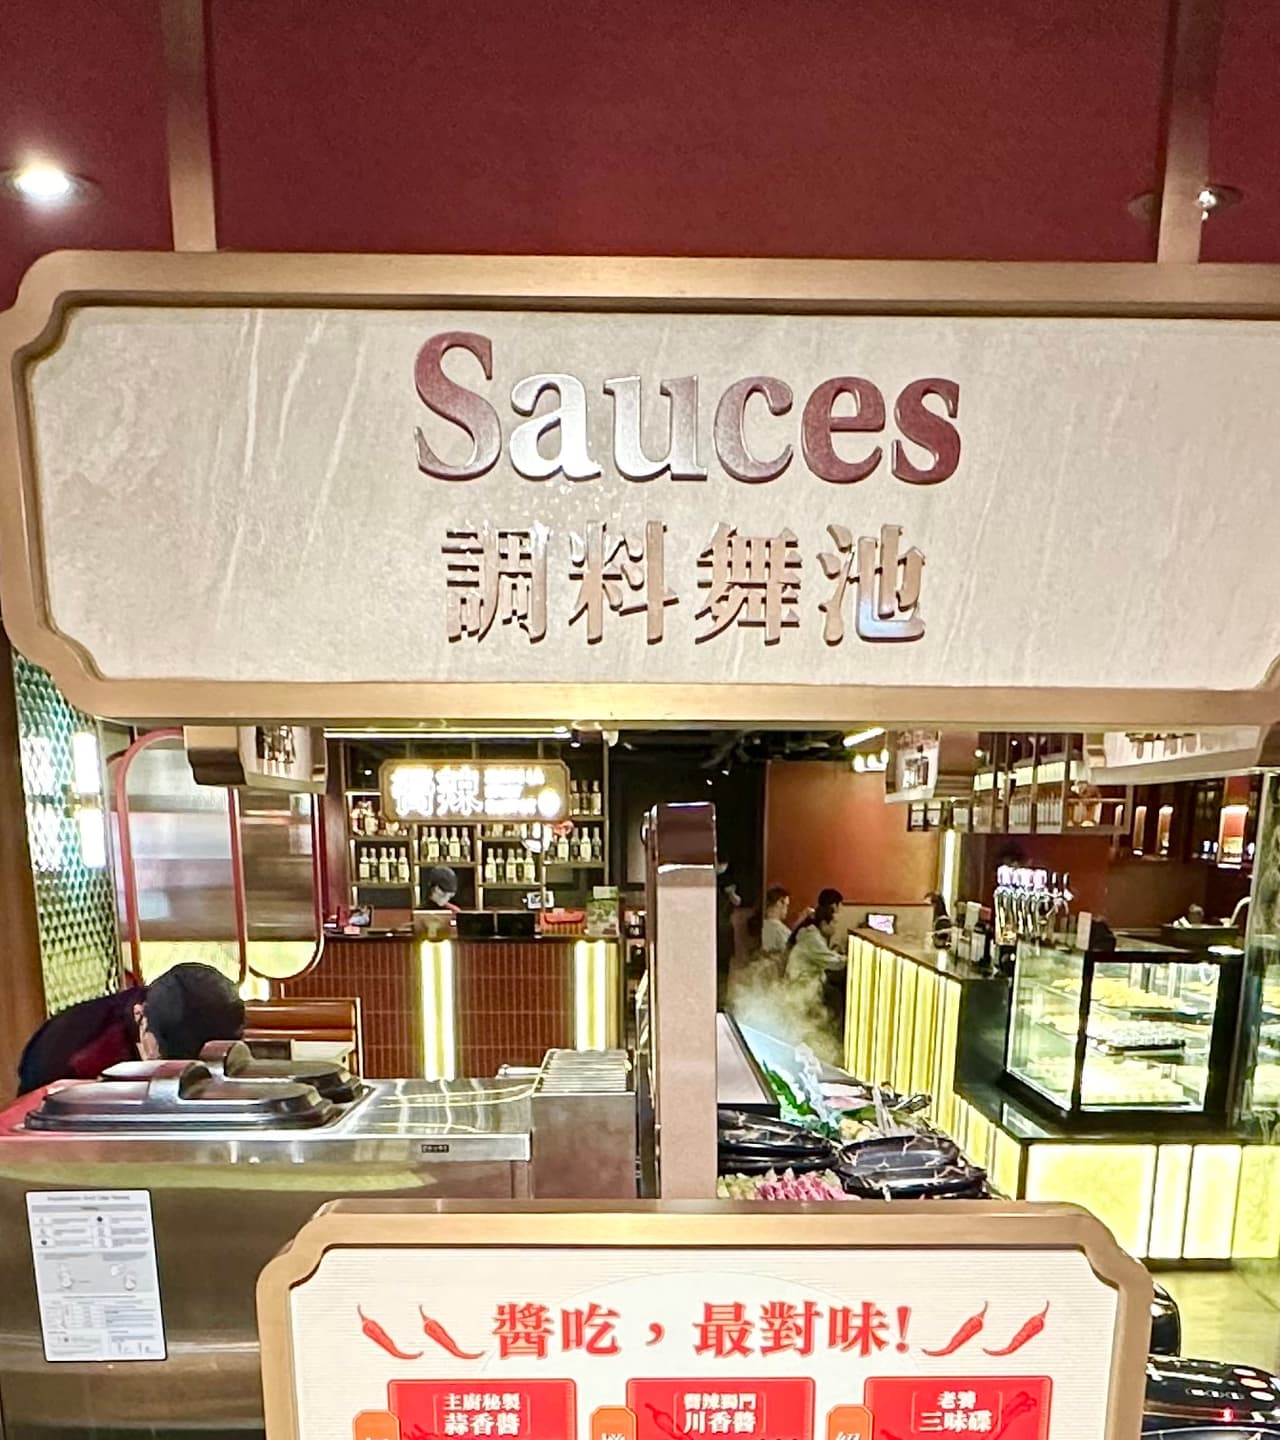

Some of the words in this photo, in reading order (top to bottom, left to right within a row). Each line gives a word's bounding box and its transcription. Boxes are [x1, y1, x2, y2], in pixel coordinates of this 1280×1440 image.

[411, 329, 964, 485] Sauces
[439, 520, 928, 648] 調料舞池
[683, 1411, 757, 1434] 川香醬
[918, 1409, 993, 1433] 三味碟
